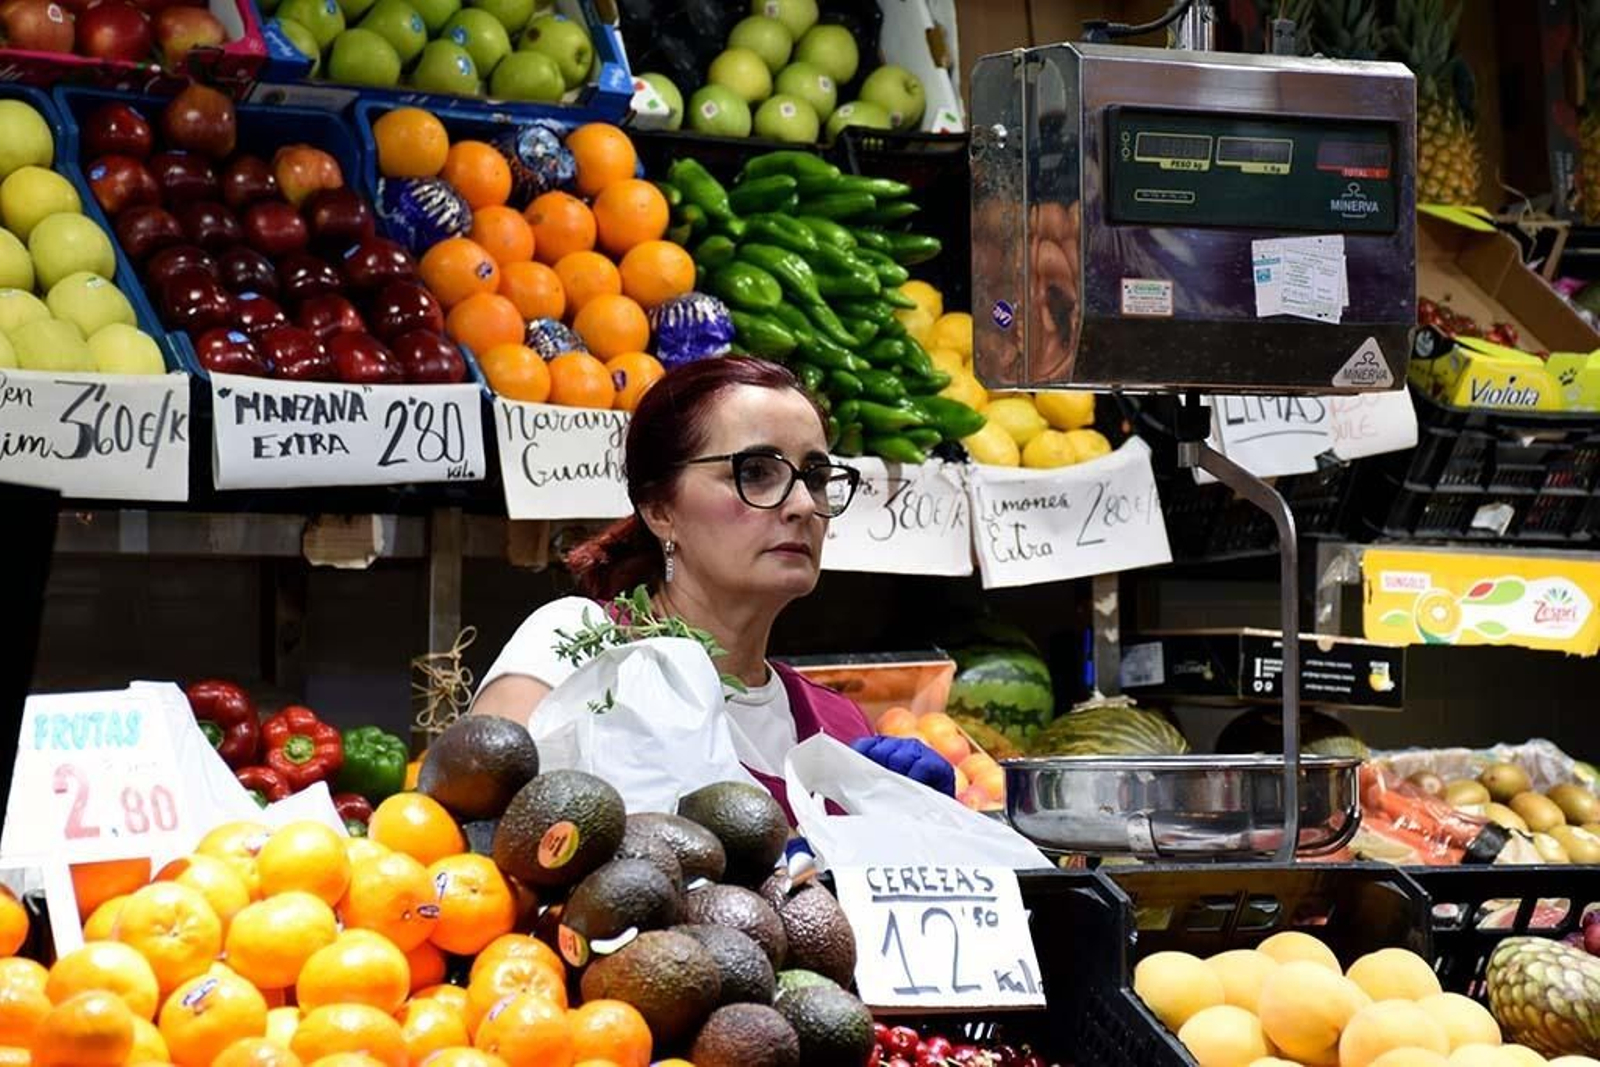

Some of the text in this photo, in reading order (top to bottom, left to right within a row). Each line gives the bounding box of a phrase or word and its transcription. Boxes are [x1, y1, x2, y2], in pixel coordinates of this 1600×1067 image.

[1342, 166, 1368, 178] TOTAL
[1331, 199, 1379, 213] MINERVA
[1342, 367, 1388, 381] MINERVA
[521, 442, 628, 488] Guach
[34, 709, 142, 751] FRUTAS
[866, 866, 994, 893] CEREZAS
